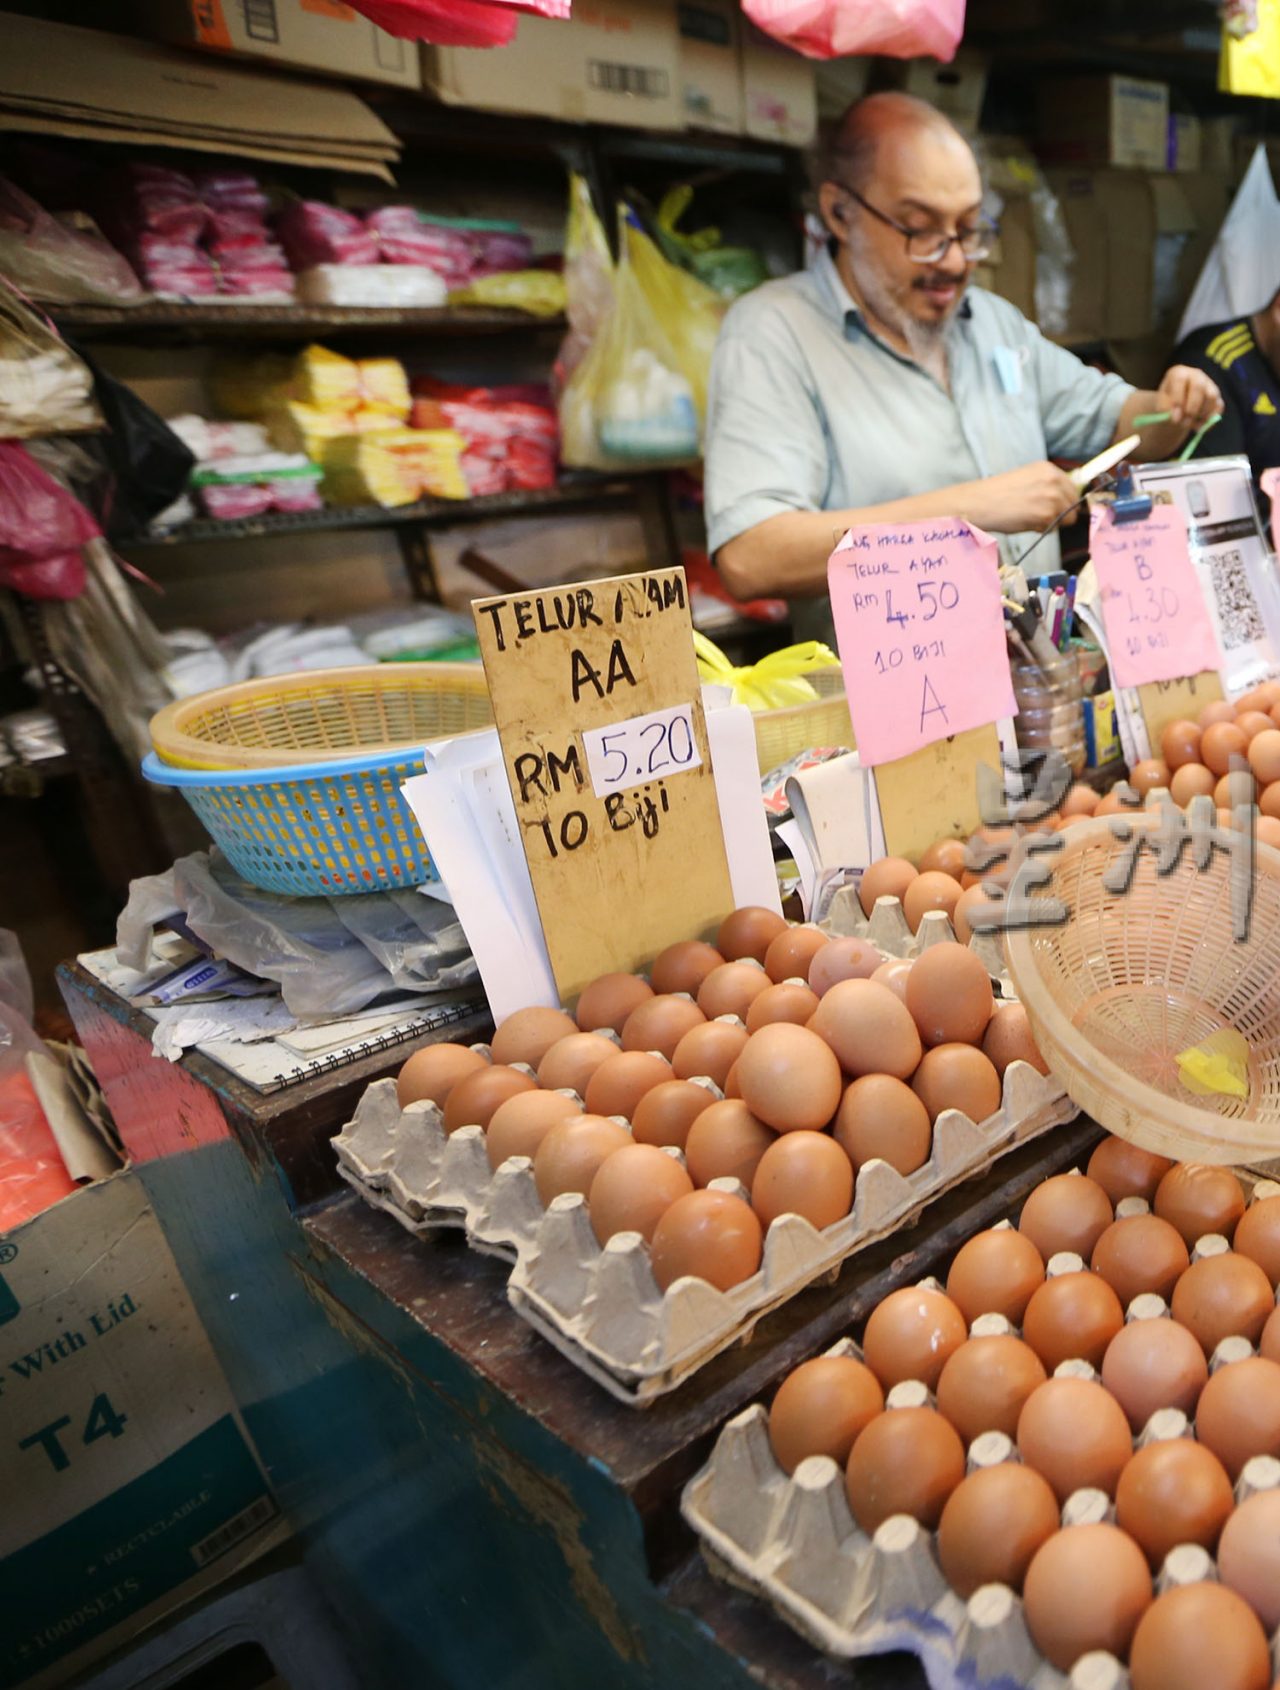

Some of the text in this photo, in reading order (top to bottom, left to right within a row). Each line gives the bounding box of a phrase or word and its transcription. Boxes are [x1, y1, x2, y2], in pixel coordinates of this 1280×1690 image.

[846, 561, 900, 581] TELUR
[478, 587, 604, 652] TELUR
[884, 580, 960, 630] 4.50
[569, 638, 638, 704] AA
[873, 648, 904, 675] 10
[919, 673, 950, 734] A
[513, 744, 585, 804] RM
[600, 714, 694, 783] 5.20
[540, 810, 589, 859] 10
[8, 1292, 138, 1380] With Lid
[18, 1391, 128, 1473] T4
